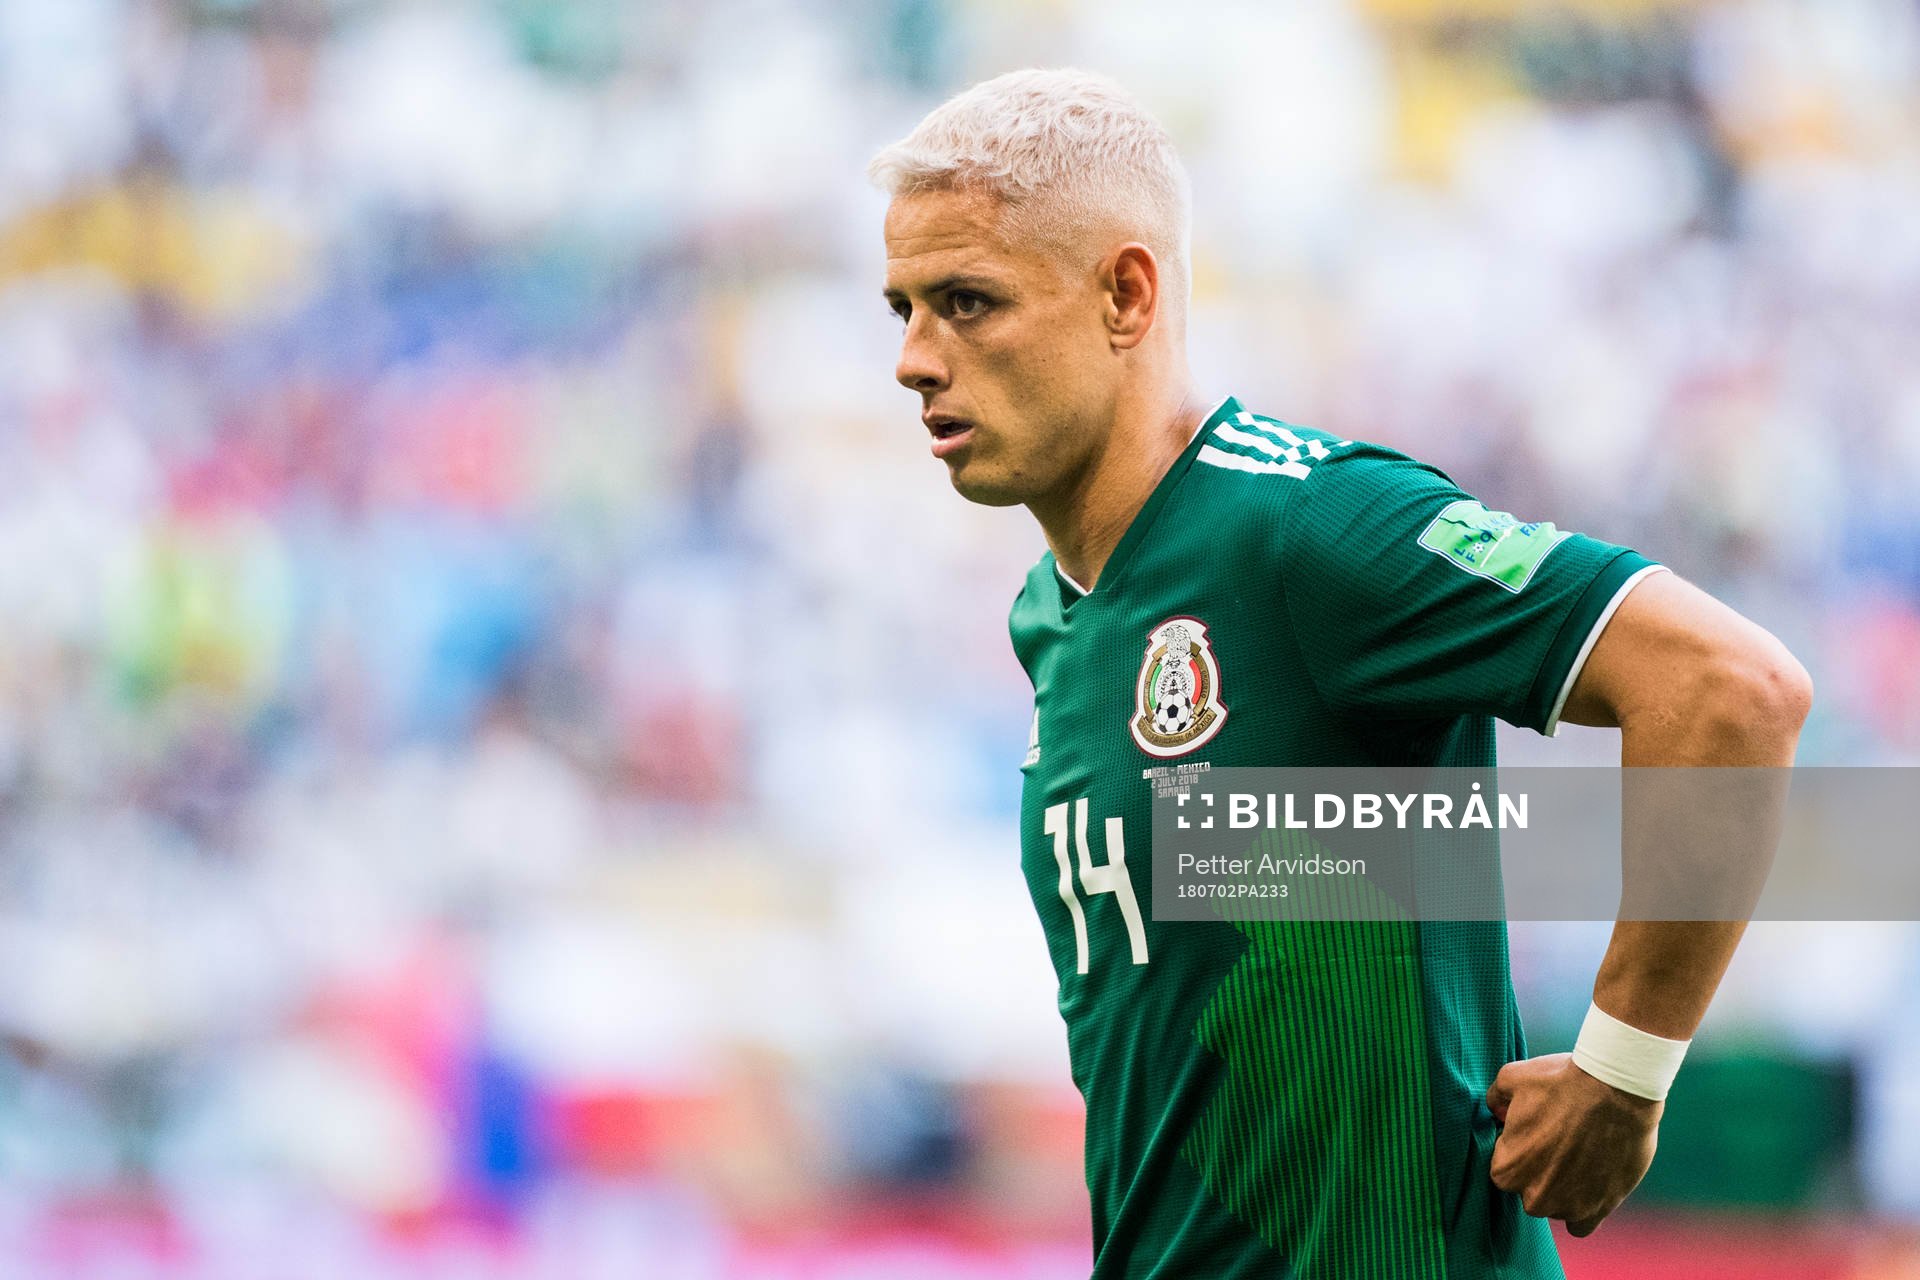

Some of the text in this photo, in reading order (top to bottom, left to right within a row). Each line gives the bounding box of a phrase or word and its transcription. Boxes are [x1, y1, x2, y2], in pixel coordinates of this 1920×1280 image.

[1143, 767, 1169, 779] BRAZIL
[1177, 761, 1211, 775] MEXICO
[1151, 774, 1199, 788] 2 JULY 2018
[1158, 785, 1190, 798] SAMARA
[1044, 797, 1149, 974] 14
